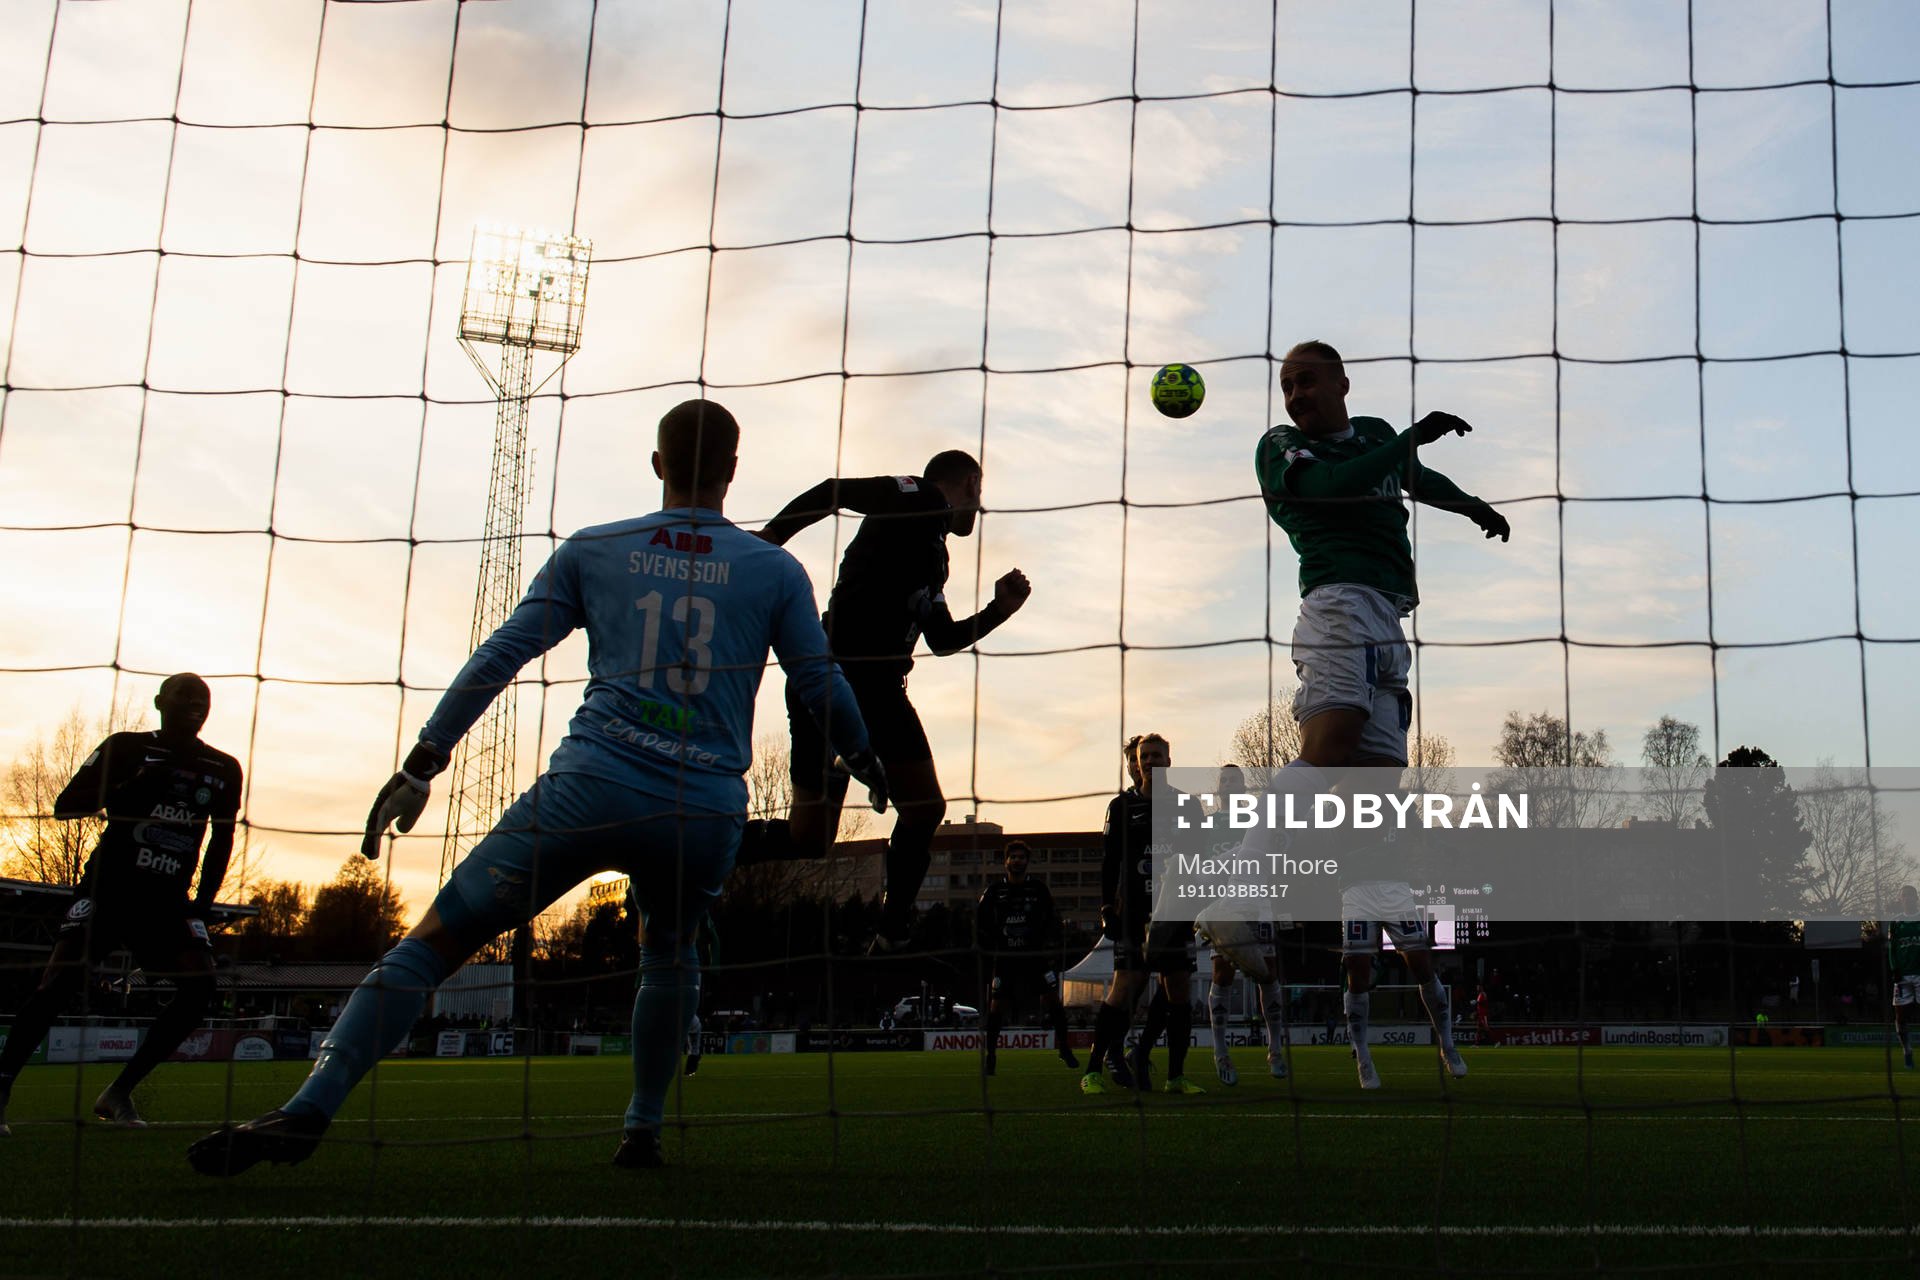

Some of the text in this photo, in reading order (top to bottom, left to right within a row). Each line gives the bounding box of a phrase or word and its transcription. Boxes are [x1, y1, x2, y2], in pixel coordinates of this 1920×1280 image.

[649, 527, 713, 555] ABB
[628, 551, 731, 585] SVENSSON
[634, 590, 716, 695] 13
[150, 803, 197, 828] ABAX
[932, 1033, 1048, 1050] ANNONBLADET
[1382, 1031, 1415, 1044] SSAB
